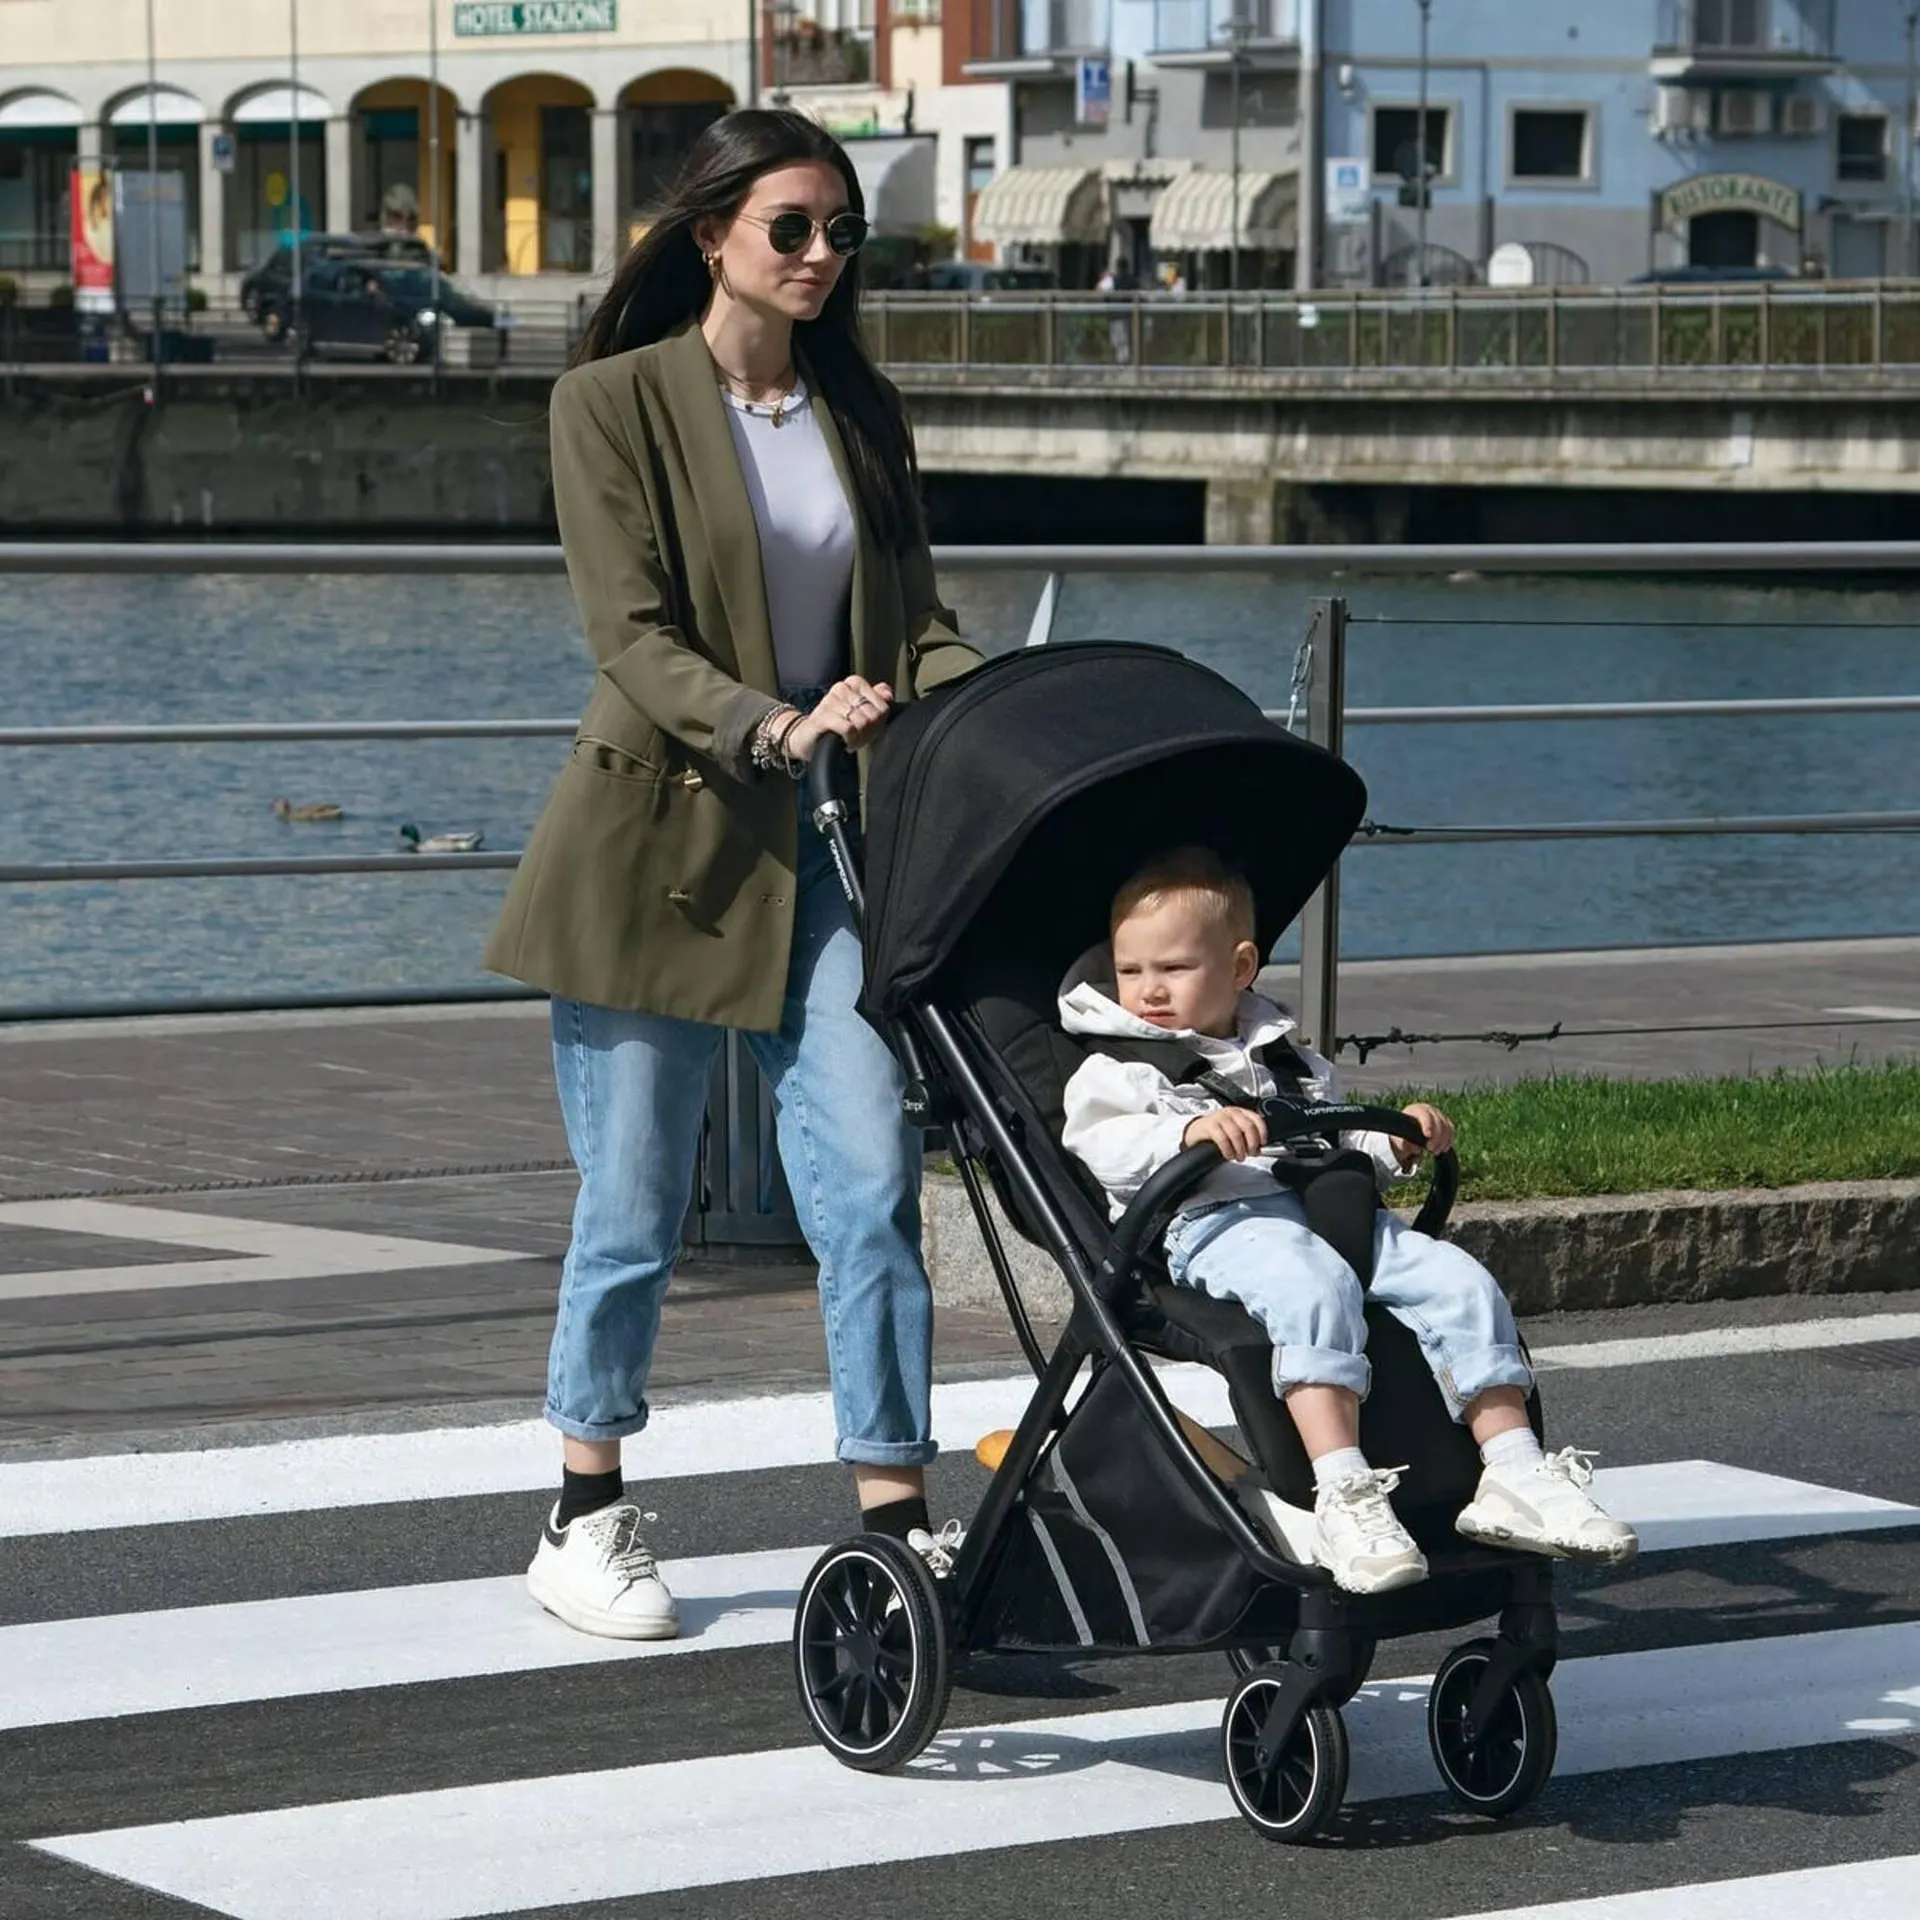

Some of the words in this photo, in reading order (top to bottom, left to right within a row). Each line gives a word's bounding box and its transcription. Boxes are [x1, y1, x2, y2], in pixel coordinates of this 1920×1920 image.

[457, 5, 514, 34] HOTEL
[521, 1, 613, 31] STAZIONE
[1667, 176, 1795, 215] RISTORANTE
